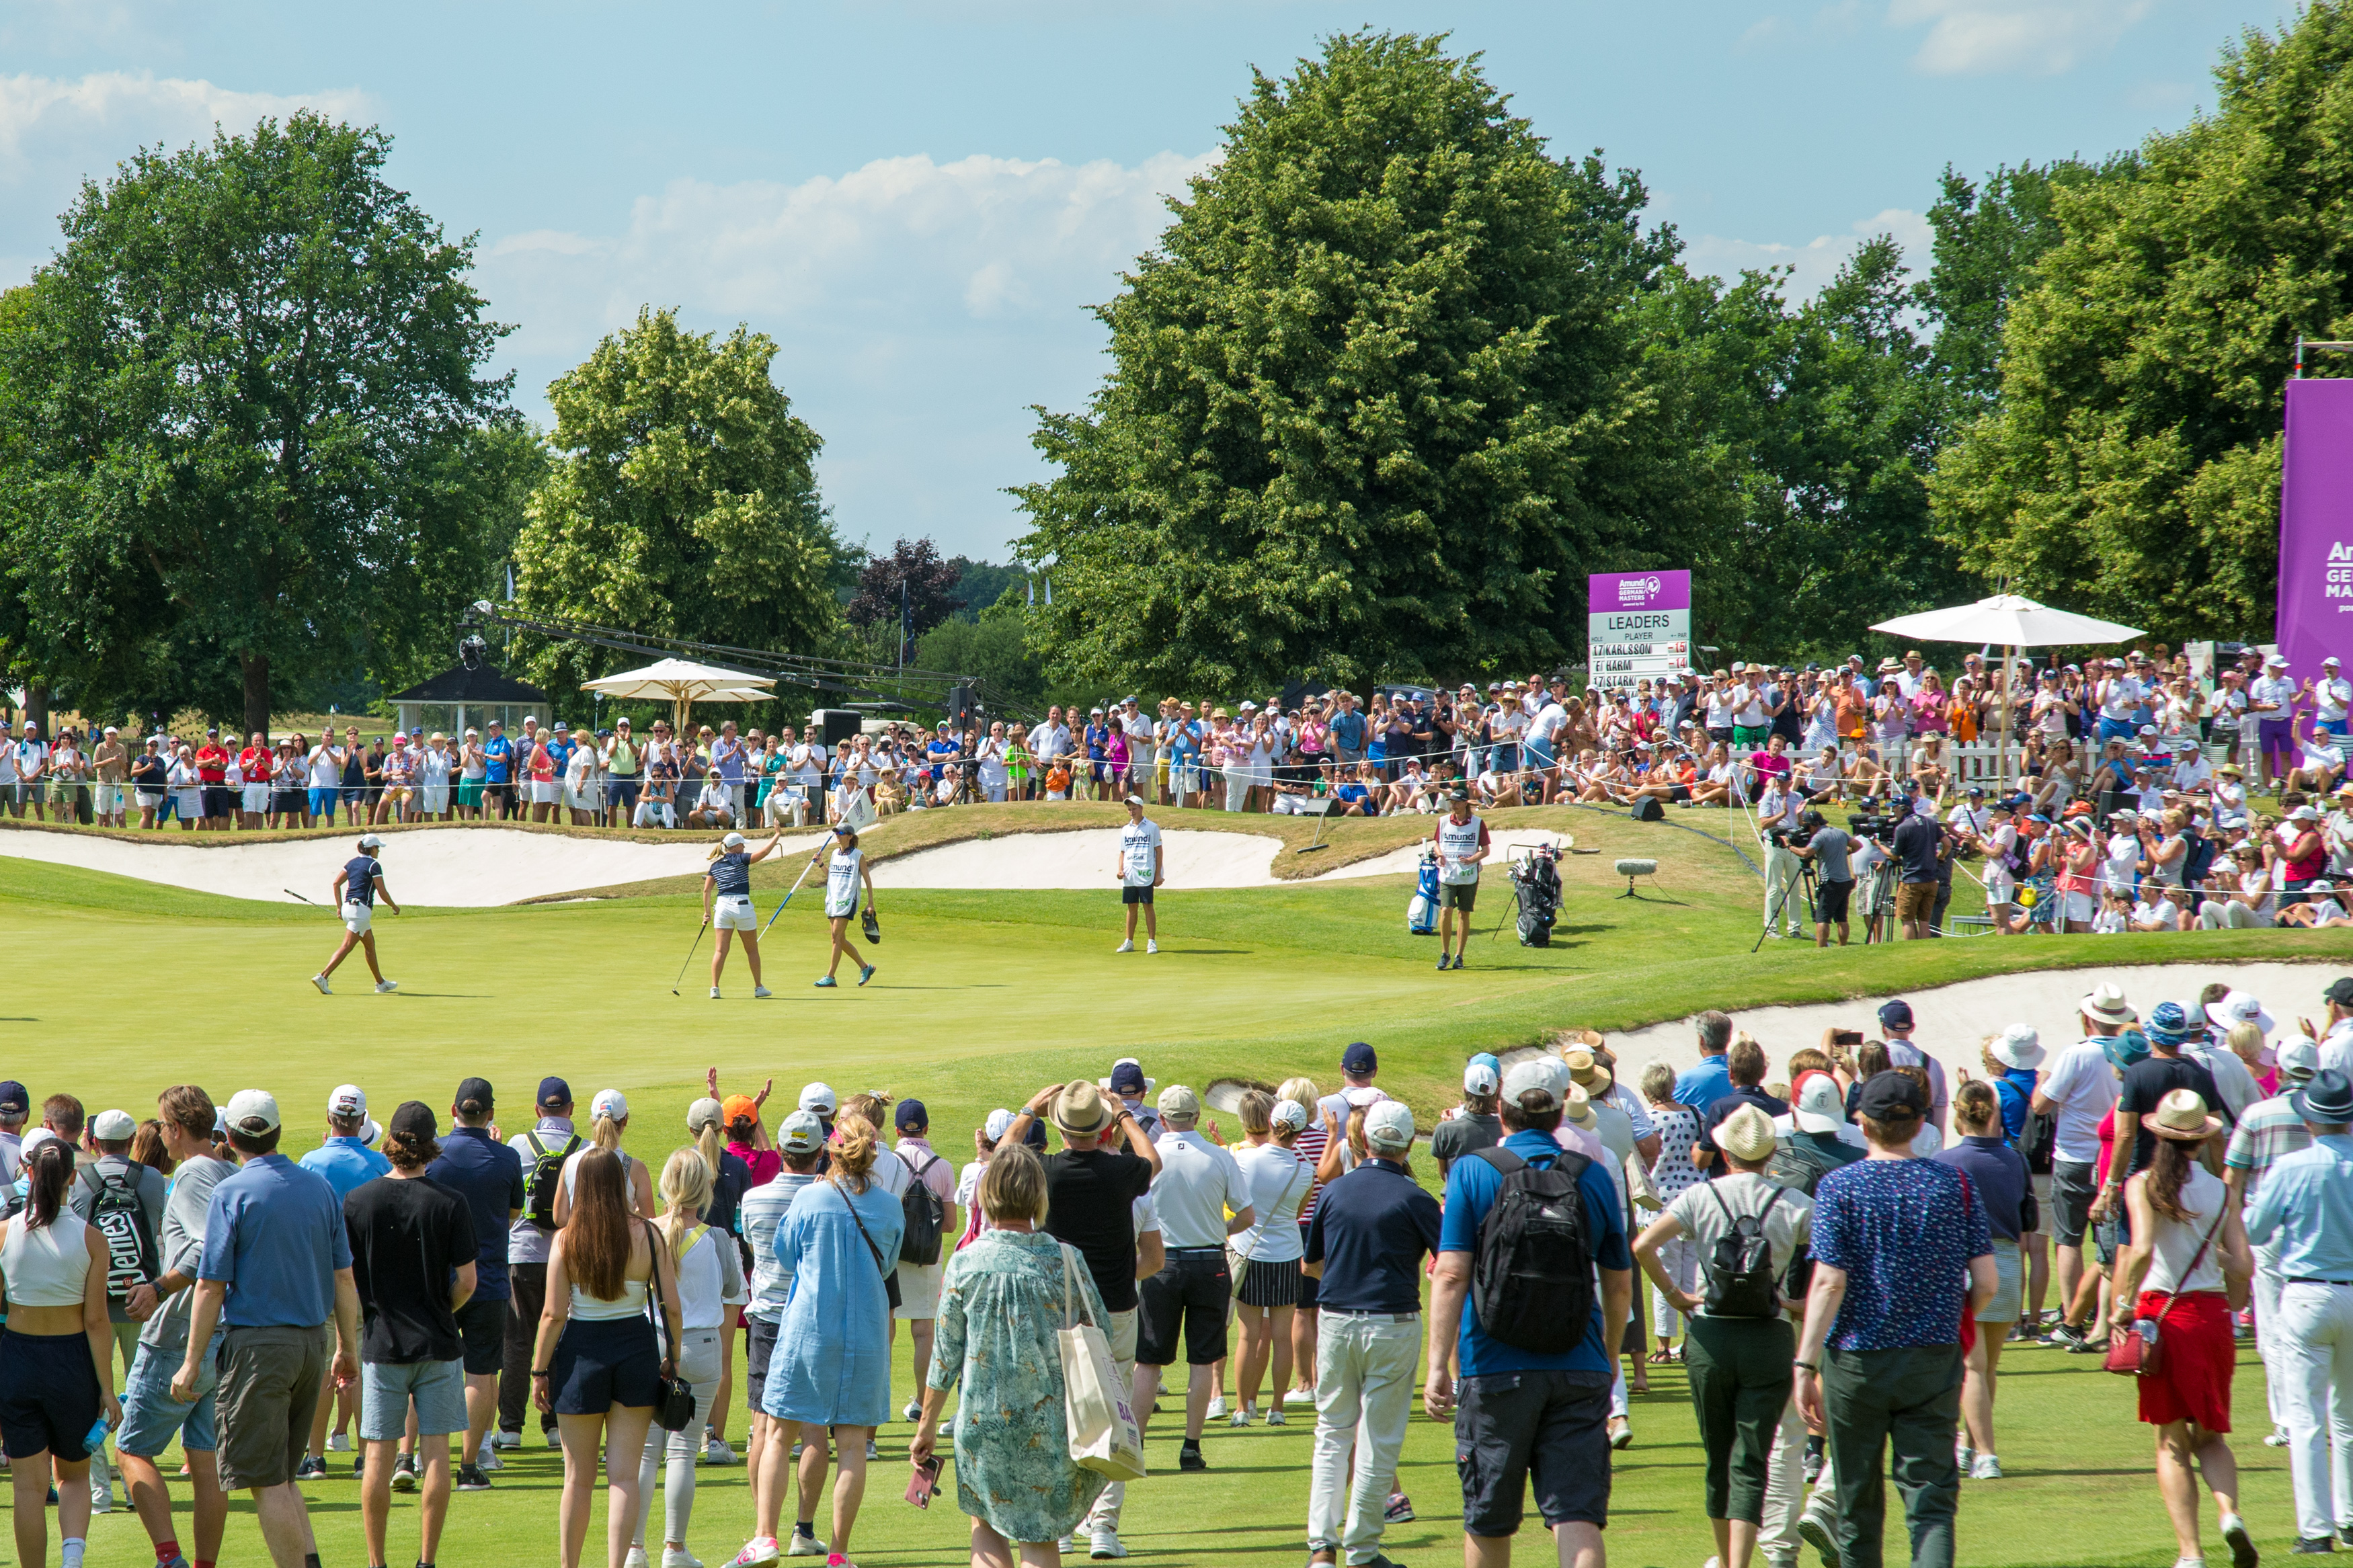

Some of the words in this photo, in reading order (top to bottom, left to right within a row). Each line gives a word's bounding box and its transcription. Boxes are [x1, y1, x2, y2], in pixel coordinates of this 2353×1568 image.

[2327, 569, 2353, 582] GE
[1619, 579, 1645, 587] Amundi
[1609, 614, 1670, 630] LEADERS
[1625, 632, 1653, 641] PLAYER
[1593, 645, 1603, 656] 17
[1605, 643, 1652, 656] KARLSSON
[1668, 642, 1685, 653] -15
[1605, 660, 1632, 671] HARM
[1669, 657, 1686, 669] -14
[1593, 676, 1603, 687] 17
[1606, 675, 1635, 687] STARK
[1125, 835, 1150, 843] Amundi
[1444, 833, 1476, 841] Amundi
[831, 864, 854, 872] mundi
